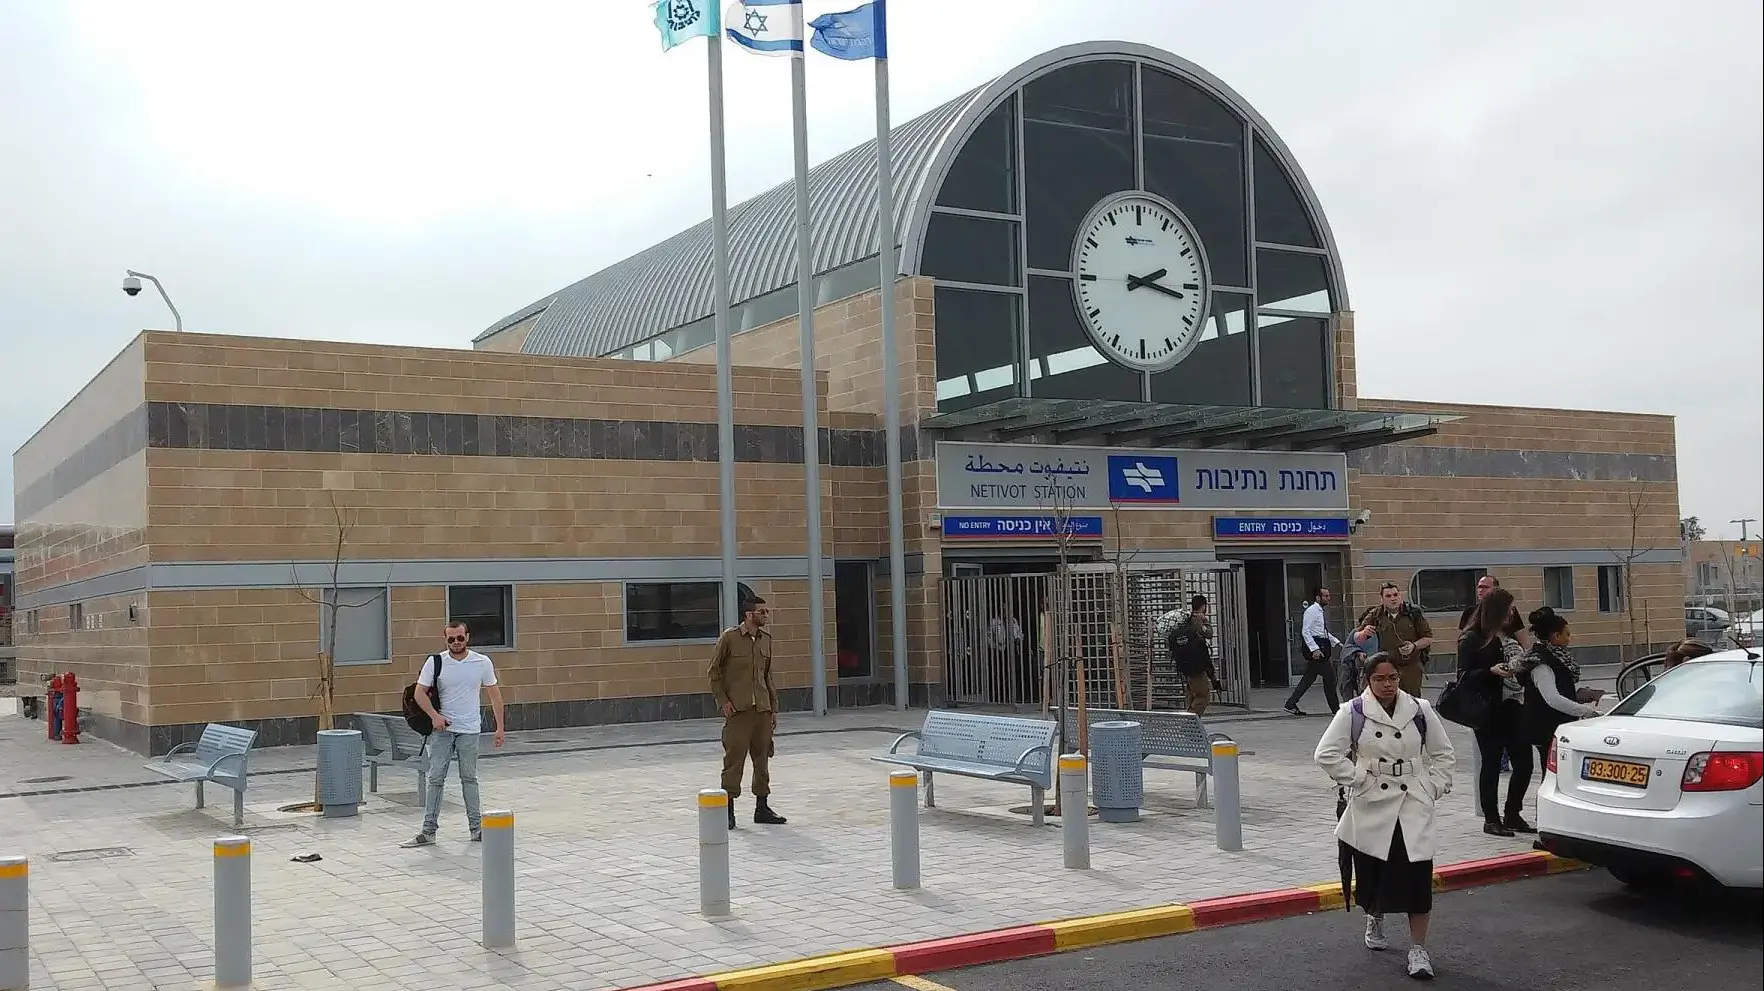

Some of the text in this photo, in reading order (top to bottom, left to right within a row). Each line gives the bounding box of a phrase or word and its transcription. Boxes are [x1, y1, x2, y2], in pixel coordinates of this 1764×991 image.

[965, 454, 1024, 475] محطة
[1196, 468, 1336, 491] תחנת נתיבות
[970, 484, 1086, 499] NETIVOT STATION
[997, 520, 1032, 531] כניסה
[1035, 520, 1051, 534] אין
[1239, 522, 1266, 532] ENTRY
[1273, 522, 1302, 532] כניסה
[1308, 521, 1327, 533] دخول
